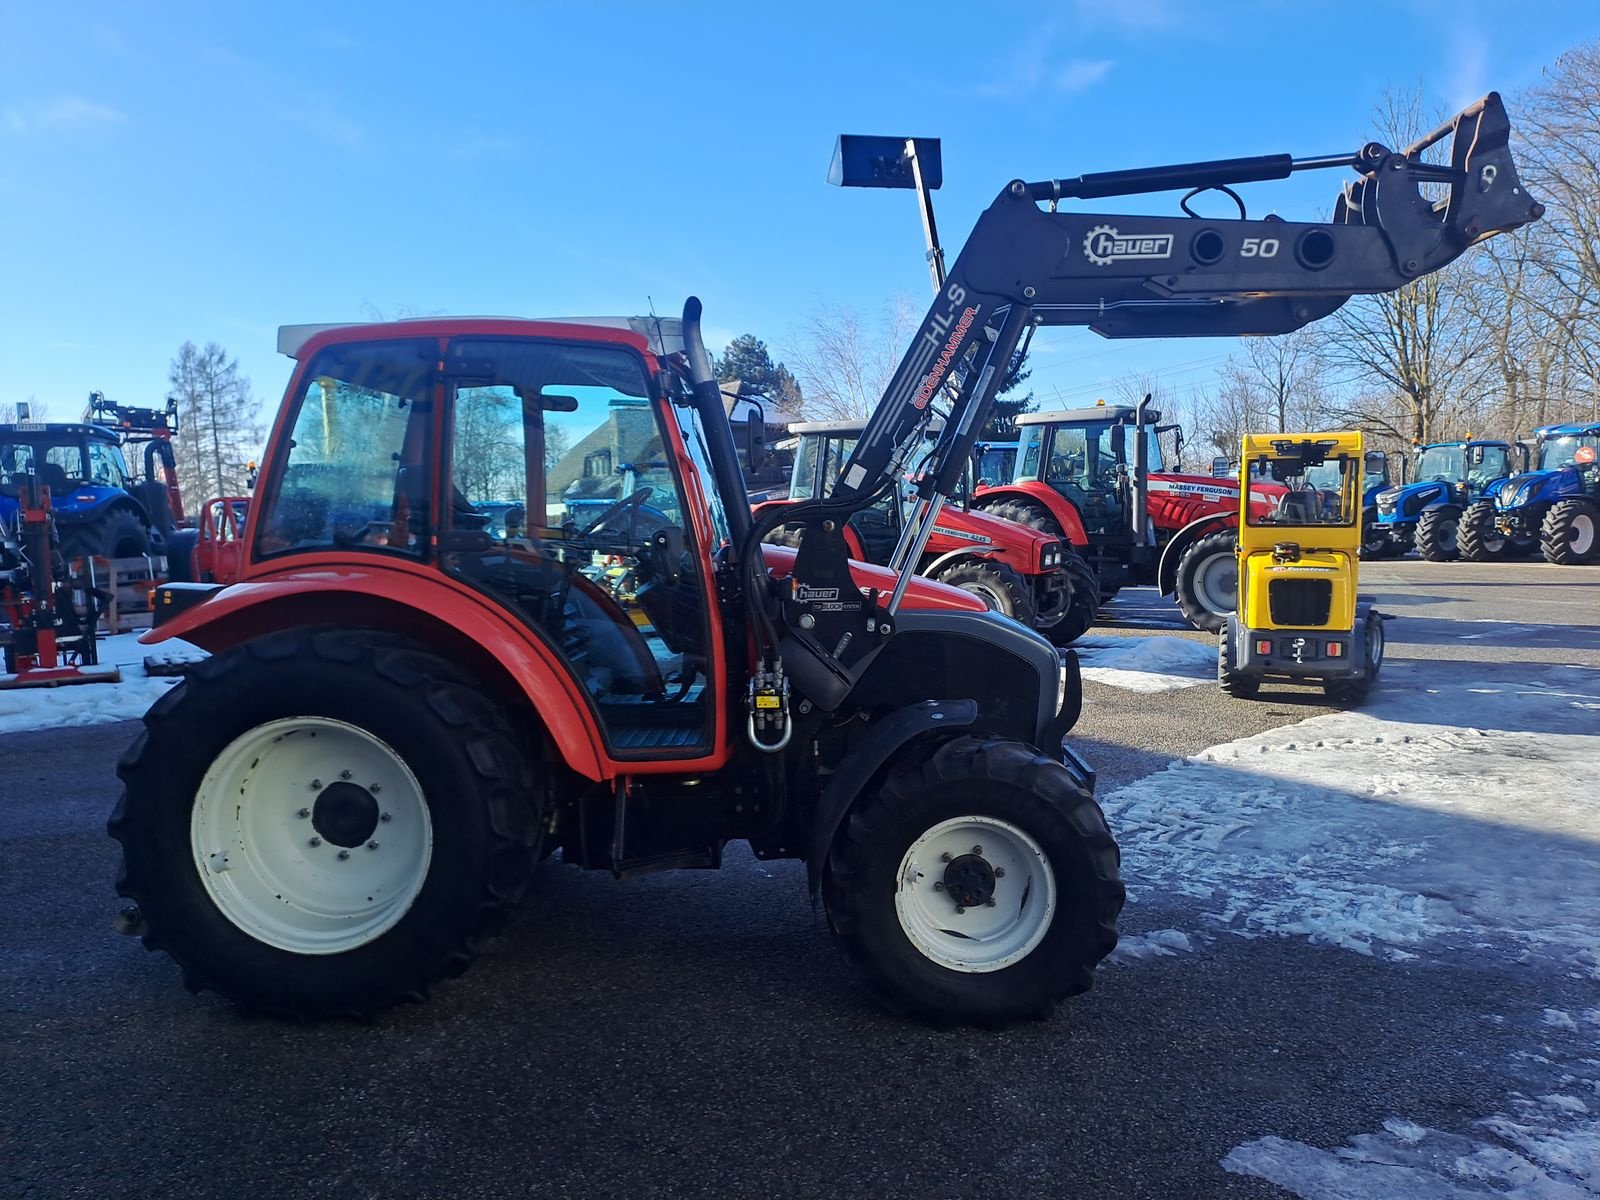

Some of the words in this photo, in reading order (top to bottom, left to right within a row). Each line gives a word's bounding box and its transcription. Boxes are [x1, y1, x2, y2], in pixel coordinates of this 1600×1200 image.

[1096, 234, 1167, 255] hauer
[1239, 238, 1280, 258] 50
[924, 283, 966, 347] HL-S
[913, 306, 977, 410] EIDENHAMMER
[1169, 484, 1196, 492] MASSEY
[1196, 485, 1233, 496] FERGUSON
[970, 534, 986, 542] 4245
[799, 587, 836, 599] hauer
